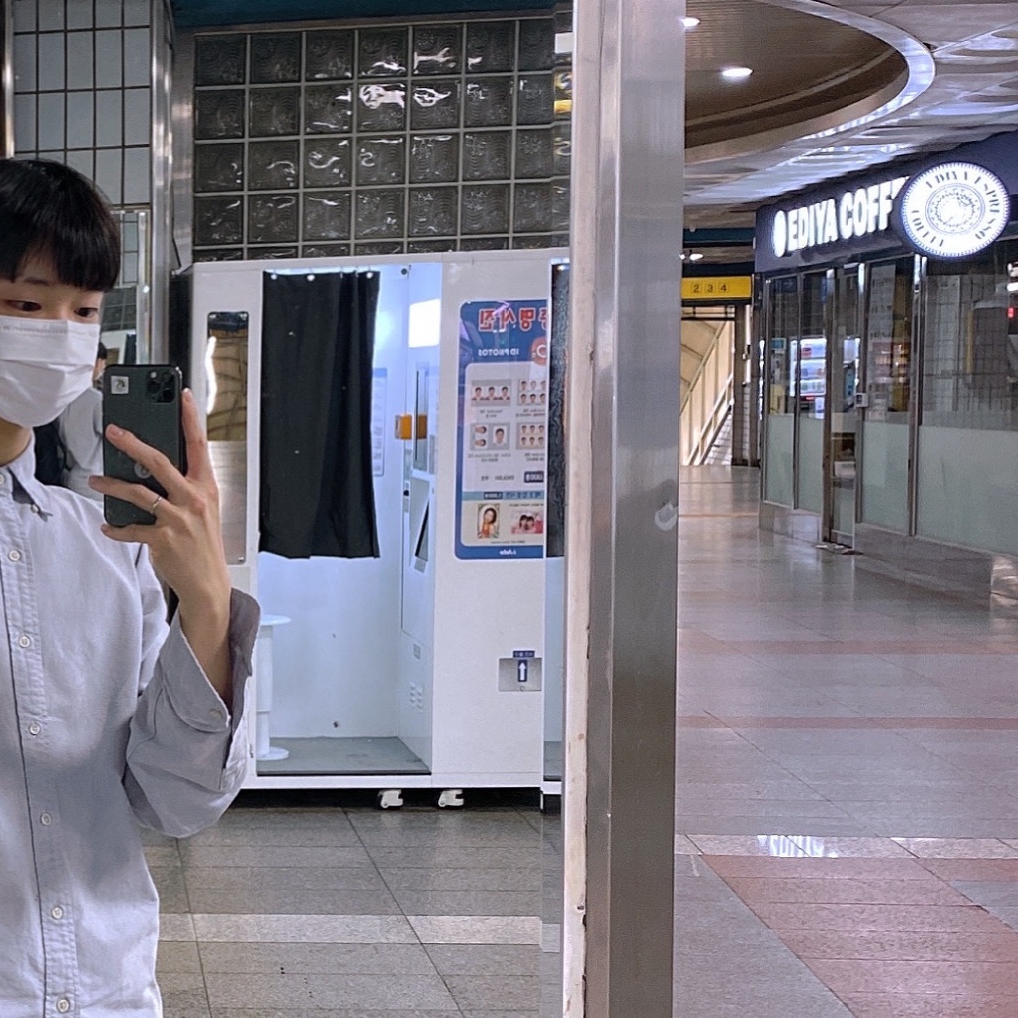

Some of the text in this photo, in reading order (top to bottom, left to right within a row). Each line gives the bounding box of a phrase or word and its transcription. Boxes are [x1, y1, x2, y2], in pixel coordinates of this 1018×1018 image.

[787, 176, 910, 252] EDIYA COFF
[693, 282, 727, 294] 2 3 4
